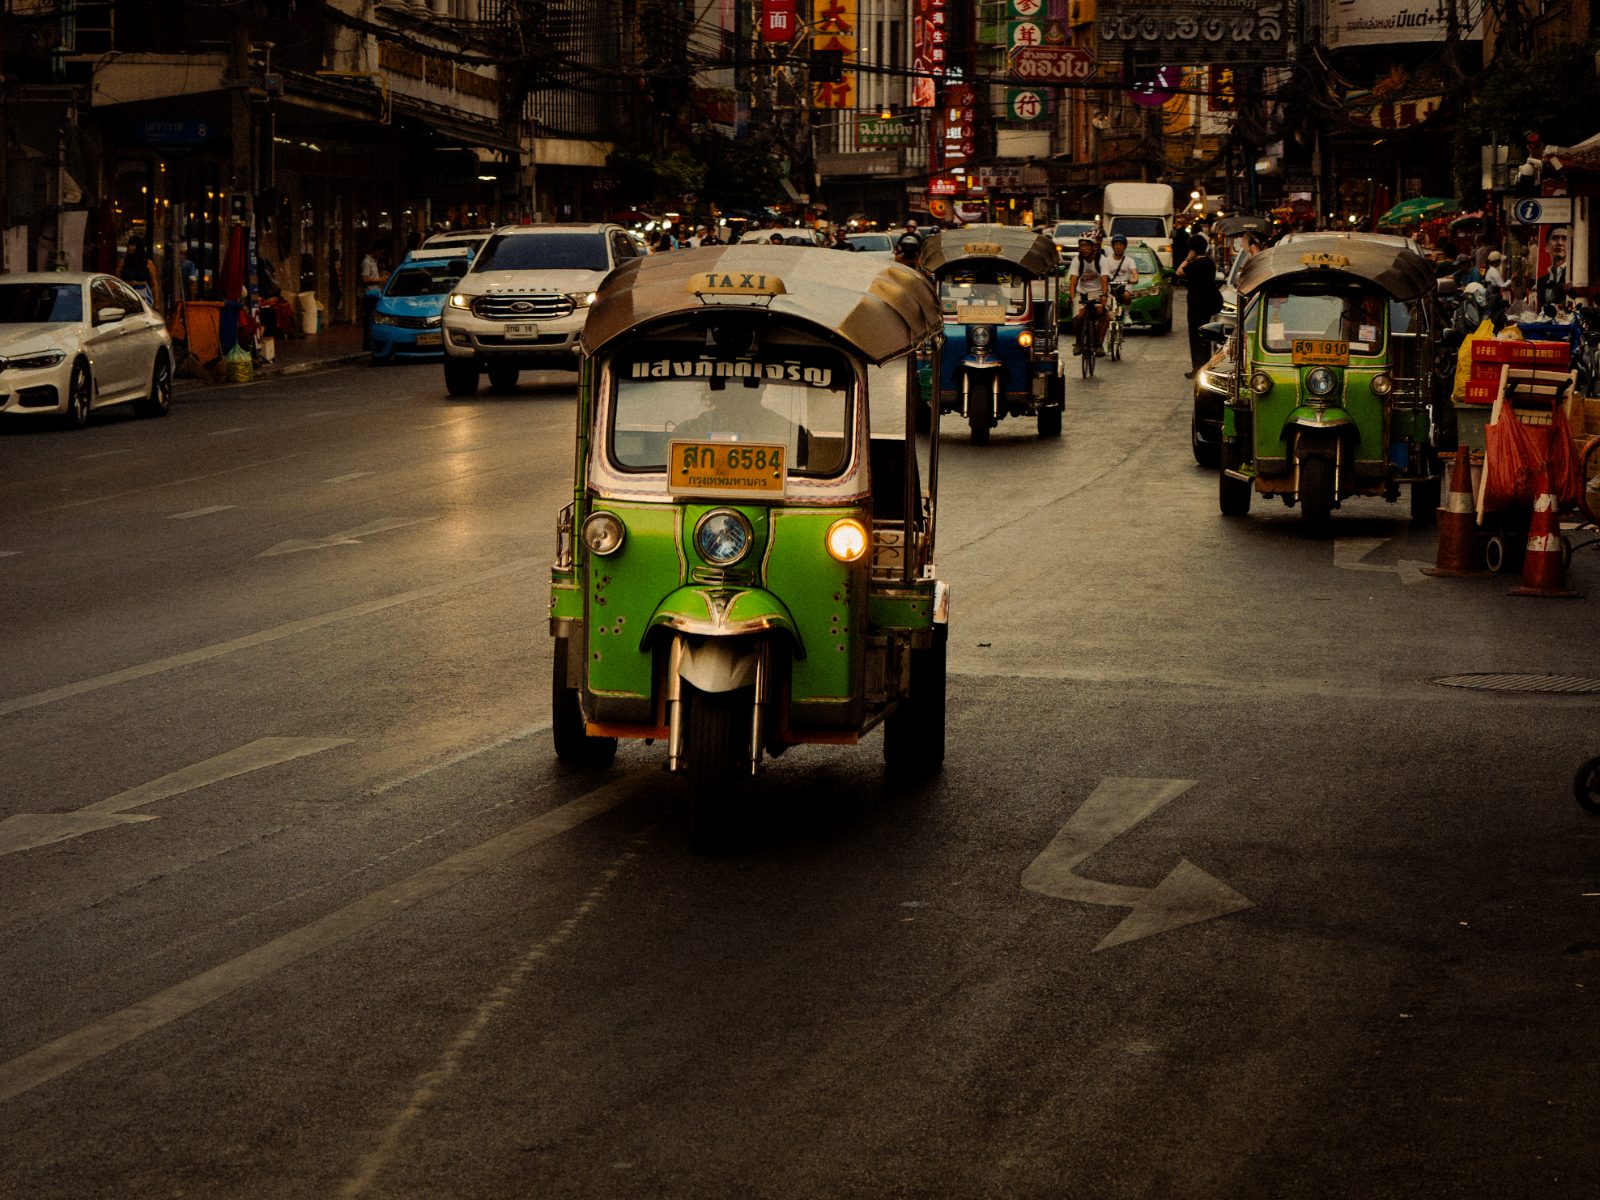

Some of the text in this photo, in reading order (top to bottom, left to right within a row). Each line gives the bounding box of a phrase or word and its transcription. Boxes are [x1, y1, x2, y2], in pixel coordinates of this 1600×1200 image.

[705, 273, 767, 290] TAXI
[682, 445, 782, 471] สก 6584
